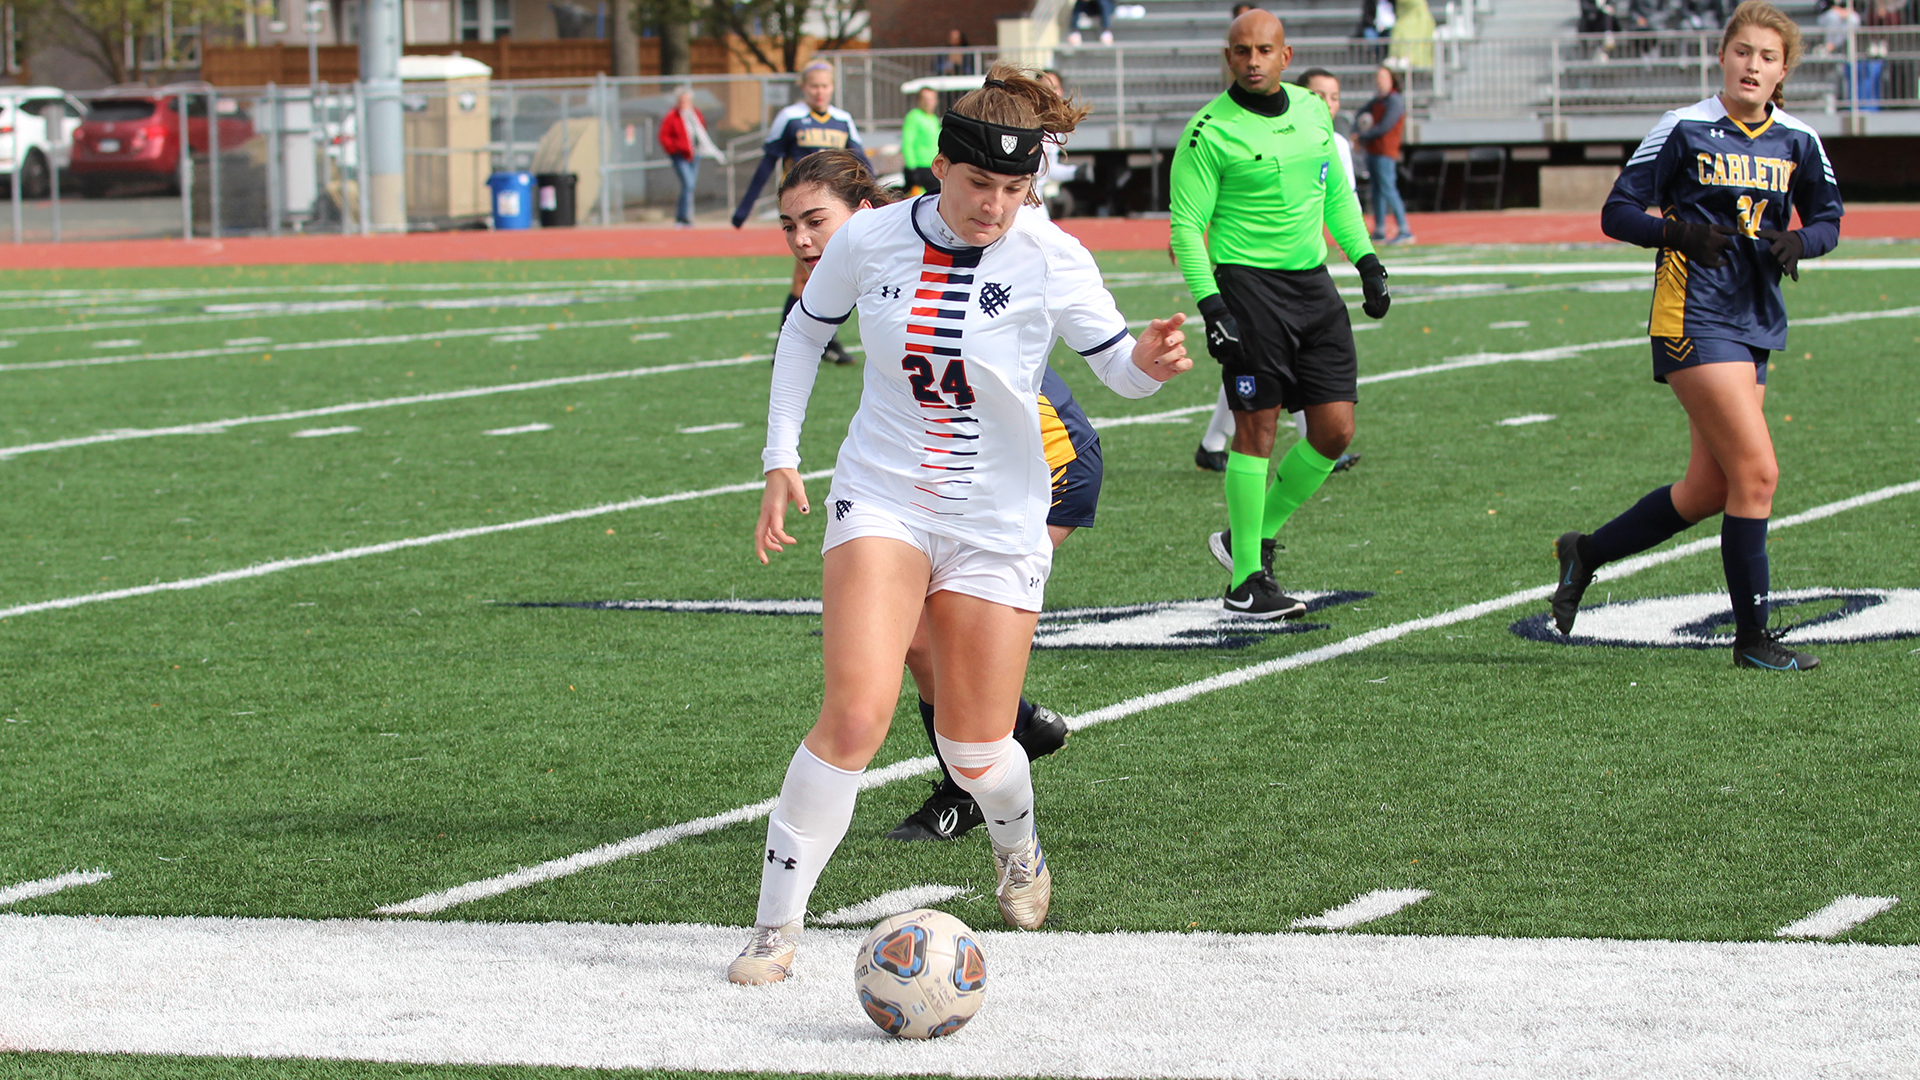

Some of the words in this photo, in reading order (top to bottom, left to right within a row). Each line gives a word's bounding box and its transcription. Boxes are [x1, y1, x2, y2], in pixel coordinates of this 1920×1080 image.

[1697, 152, 1797, 193] CARLETO
[1736, 195, 1769, 240] 21
[901, 353, 977, 405] 24
